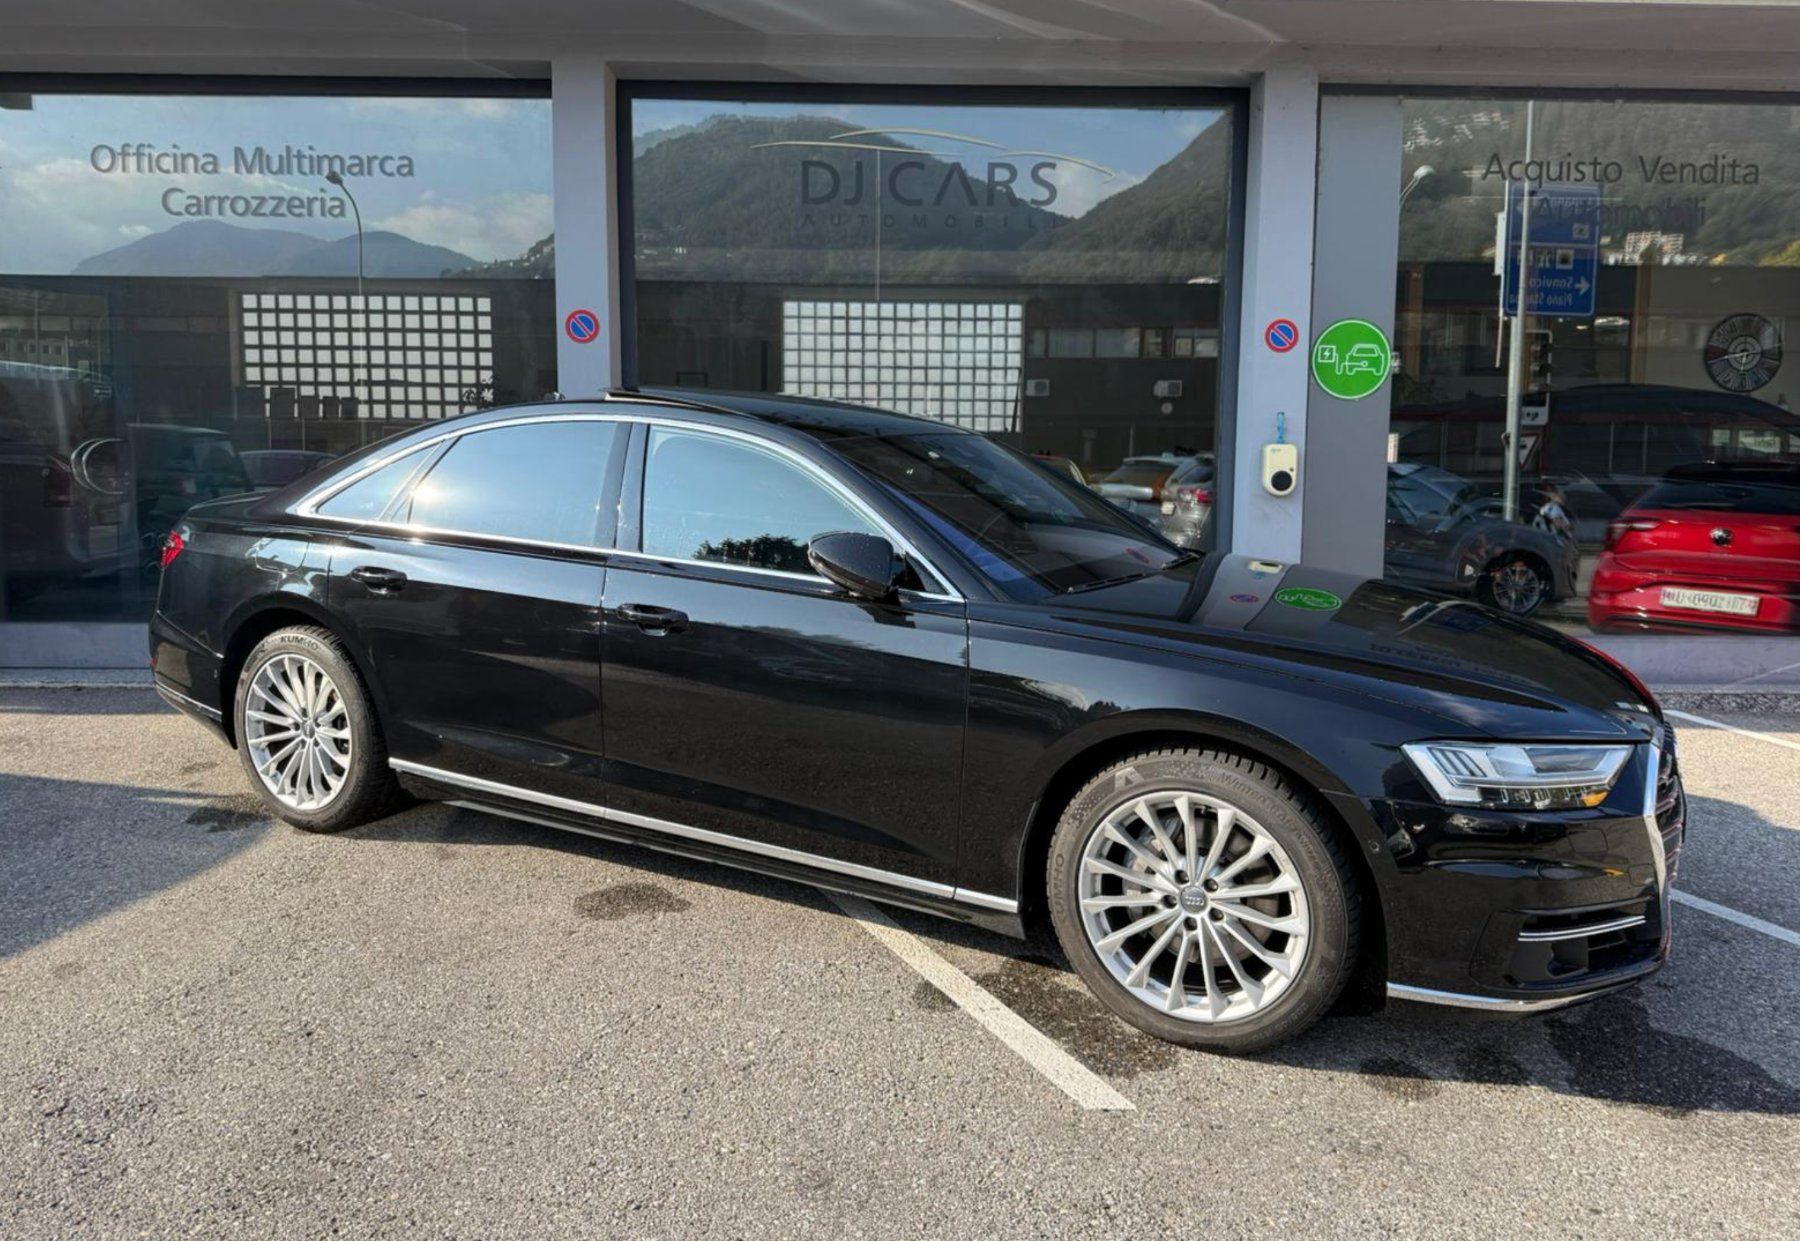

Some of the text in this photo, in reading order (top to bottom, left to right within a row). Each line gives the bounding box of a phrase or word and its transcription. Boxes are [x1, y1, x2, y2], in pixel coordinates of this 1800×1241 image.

[90, 143, 414, 177] Officina Multimarca
[1481, 153, 1760, 189] Acquisto Vendita
[801, 160, 1058, 206] DJ CARS
[162, 187, 347, 218] Carrozzeria
[1537, 197, 1707, 228] Automobili
[280, 635, 319, 651] KUMHO
